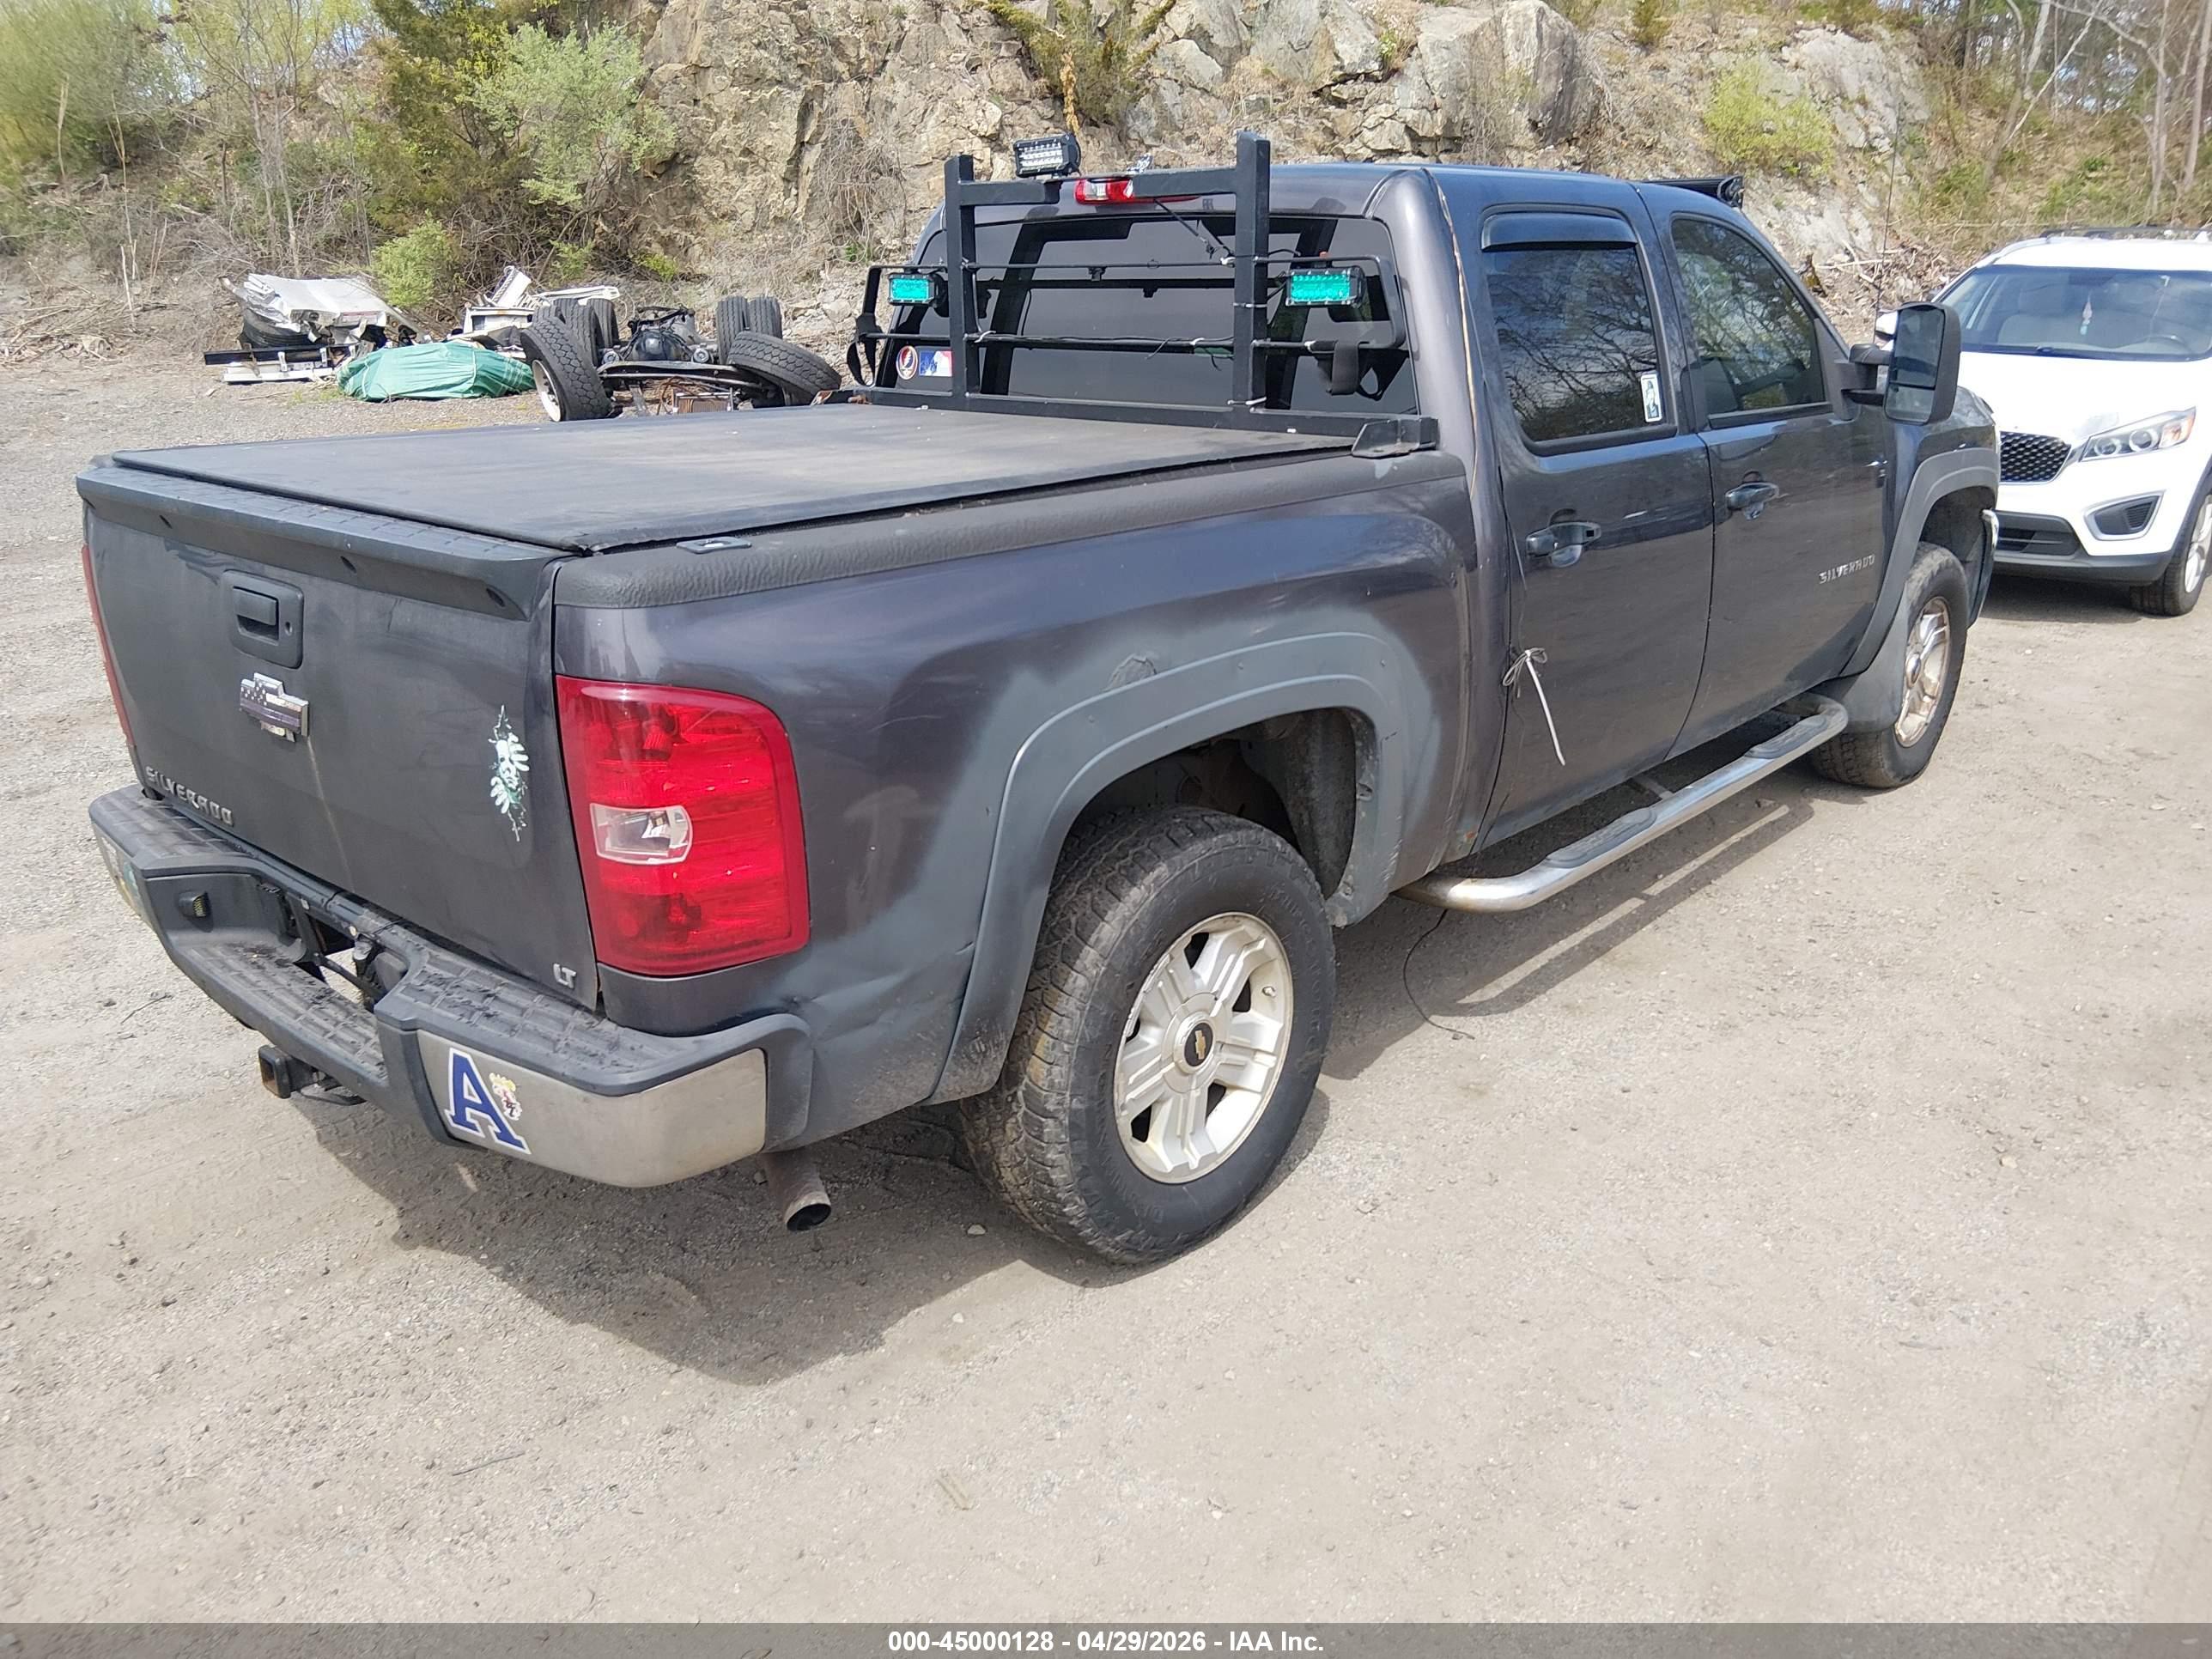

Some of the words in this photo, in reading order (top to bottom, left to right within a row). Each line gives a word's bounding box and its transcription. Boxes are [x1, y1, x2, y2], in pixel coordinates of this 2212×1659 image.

[1819, 554, 1875, 584] SILVERADO
[145, 765, 233, 825] SILVERADO
[553, 963, 576, 988] LT
[444, 1047, 532, 1155] A
